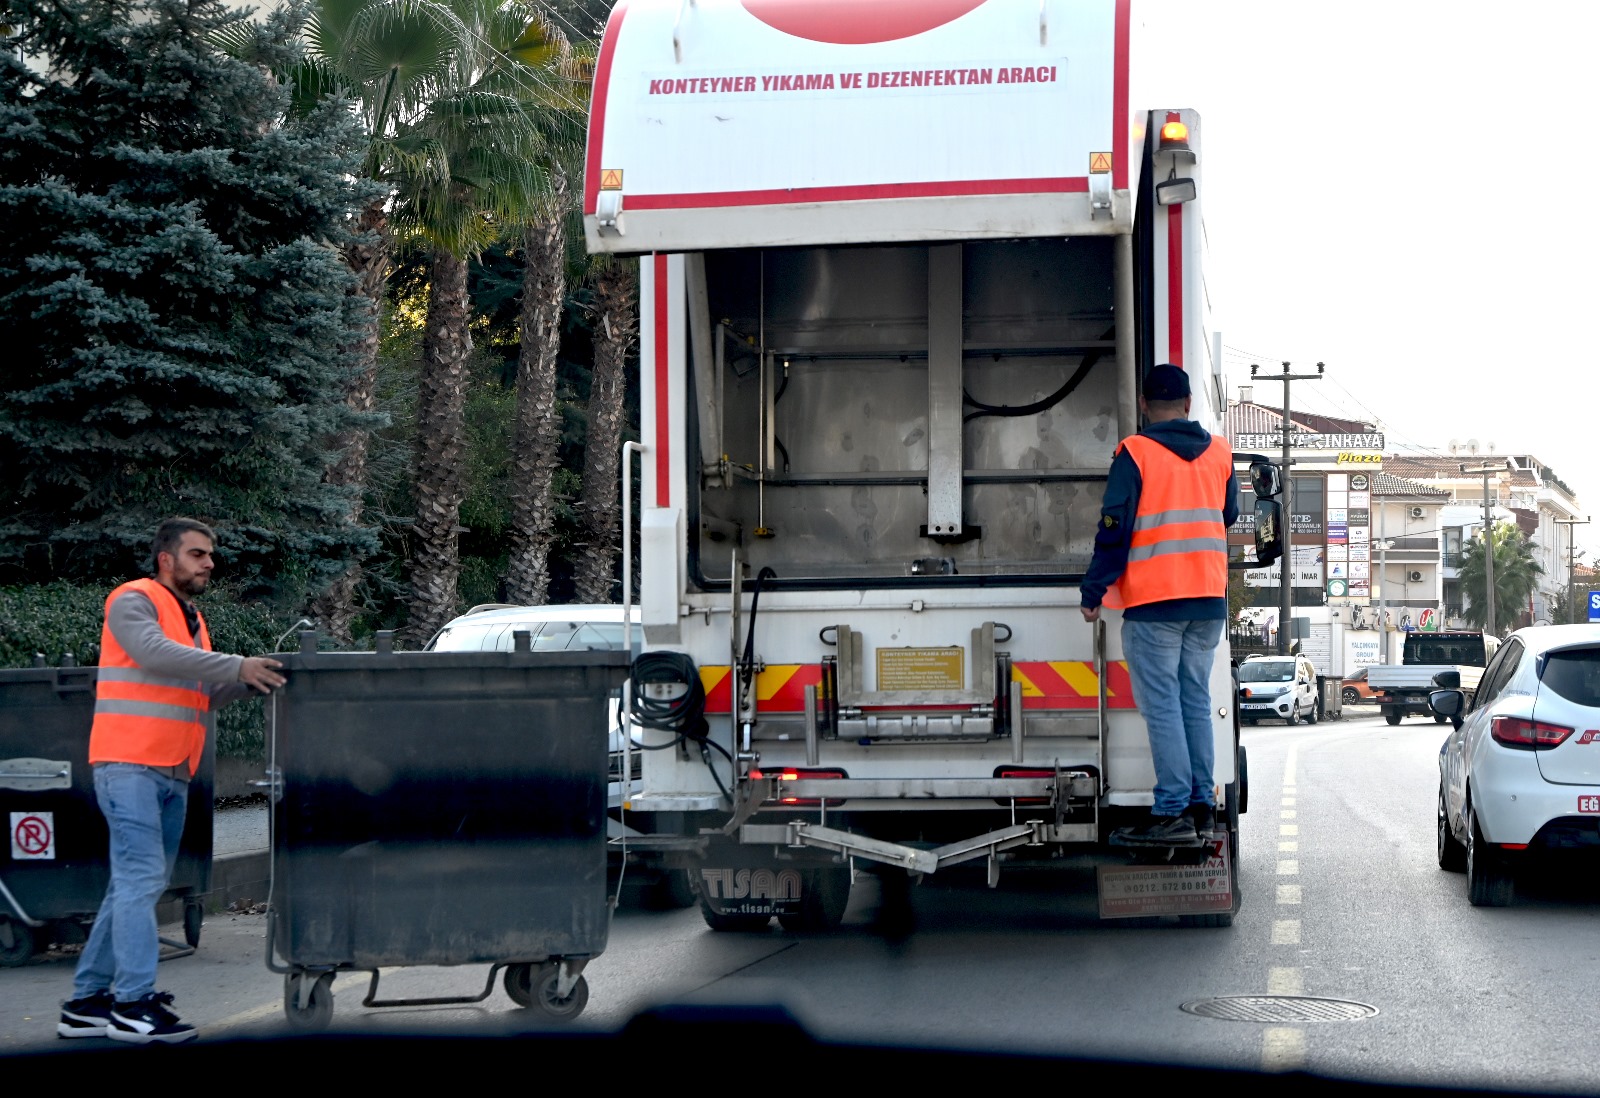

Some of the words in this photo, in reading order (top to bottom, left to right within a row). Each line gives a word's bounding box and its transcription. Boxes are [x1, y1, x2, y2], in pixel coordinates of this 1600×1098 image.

[649, 76, 757, 95] KONTEYNER
[762, 73, 835, 92] YIKAMA
[840, 72, 863, 89] VE
[866, 68, 993, 88] DEZENFEKTAN
[997, 66, 1057, 84] ARACI
[1337, 452, 1382, 465] Plaza
[1301, 571, 1318, 580] İMAR
[701, 868, 802, 899] TISAN
